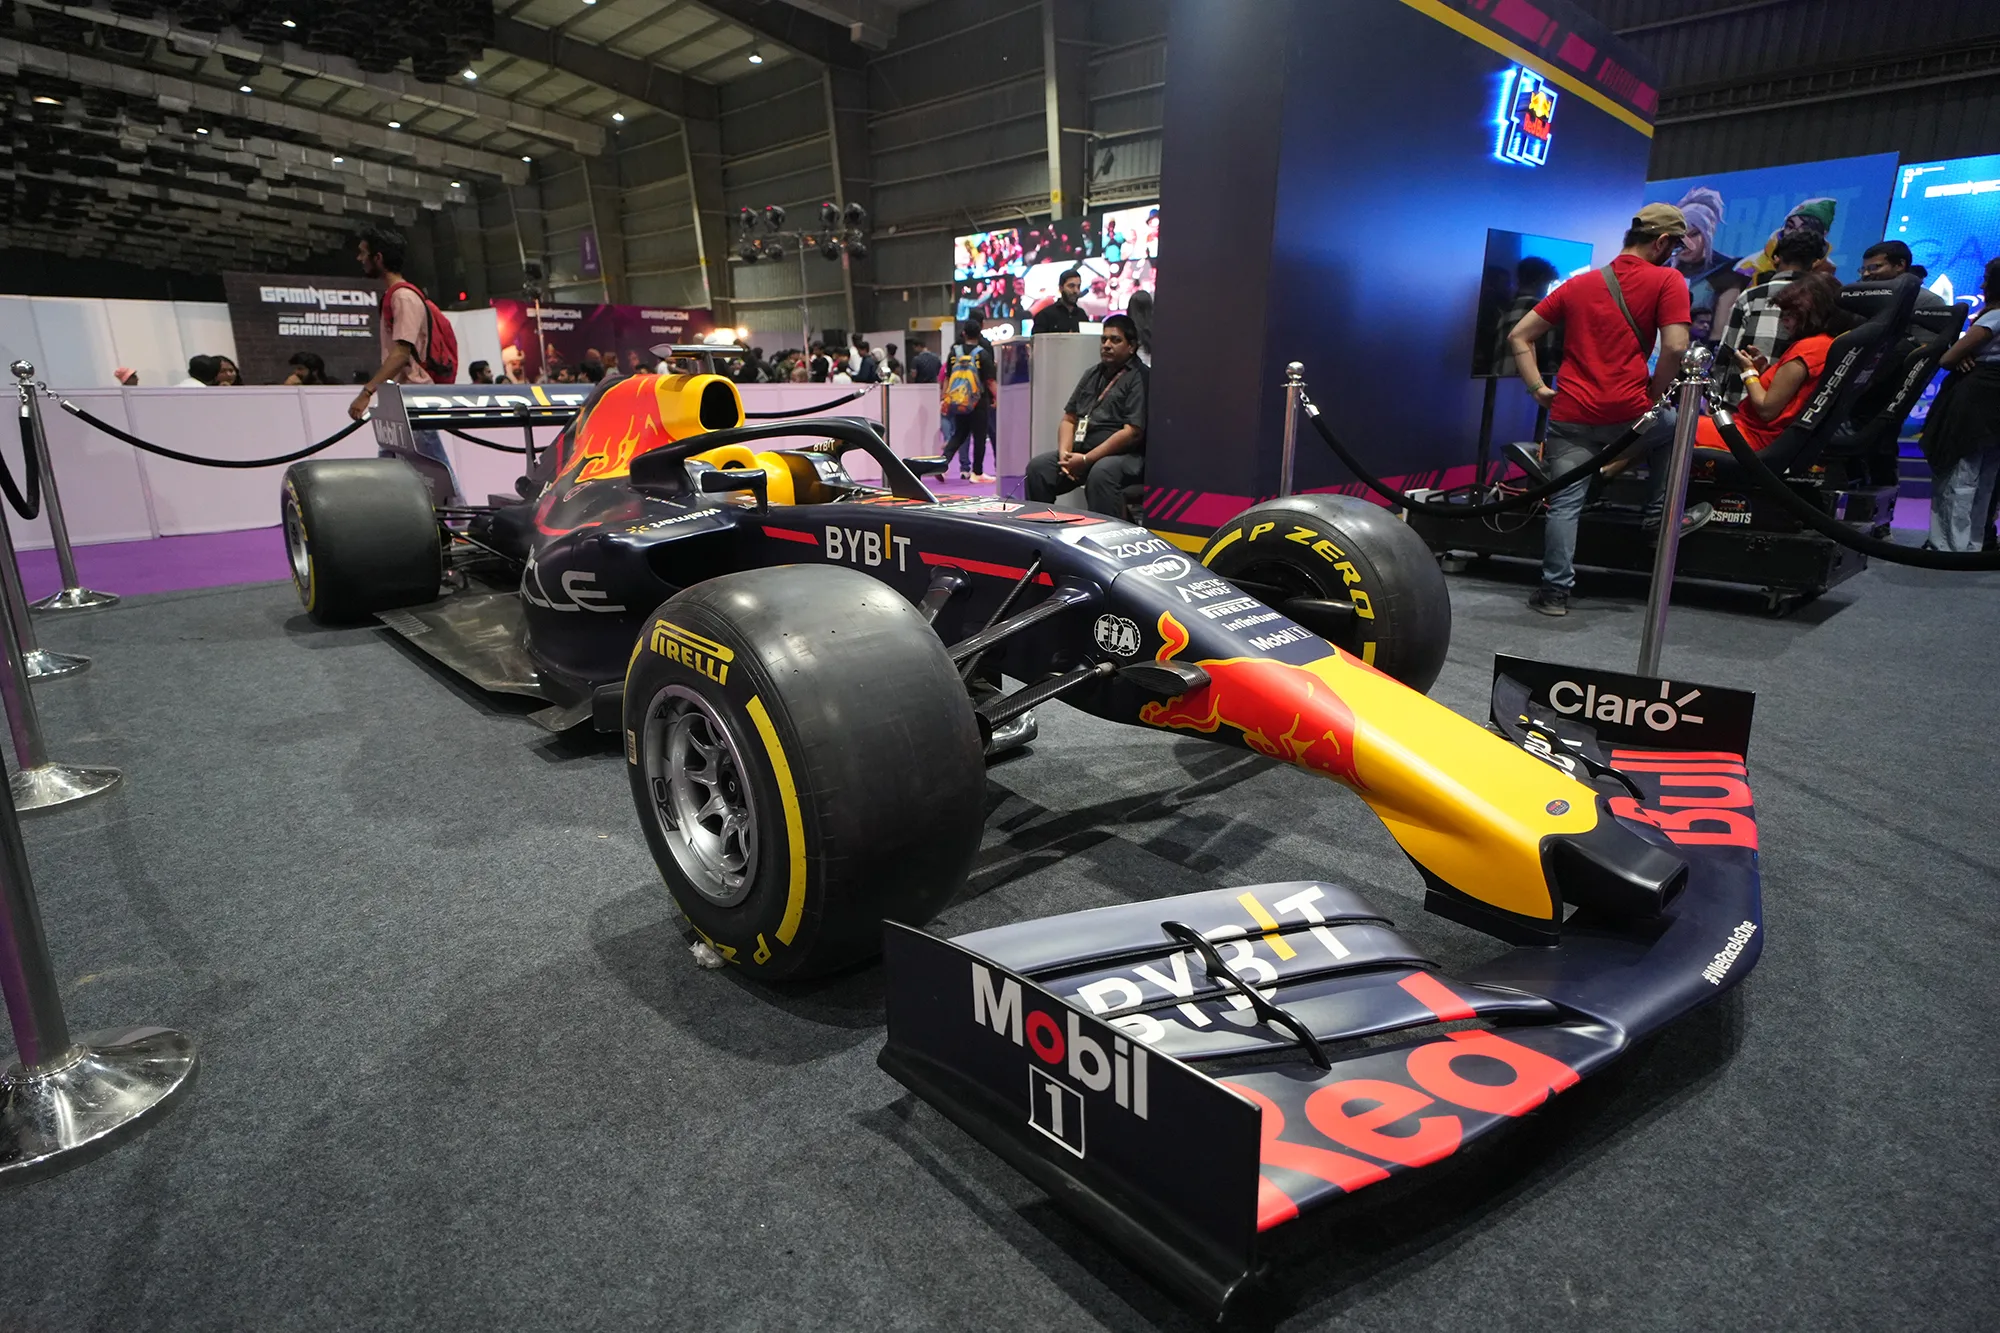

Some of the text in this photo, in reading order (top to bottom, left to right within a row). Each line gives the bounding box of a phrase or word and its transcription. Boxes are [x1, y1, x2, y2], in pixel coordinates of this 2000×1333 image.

[260, 285, 378, 310] GAMINGCON
[279, 323, 338, 337] GAMING
[305, 312, 370, 326] BIGGEST
[649, 508, 721, 528] Walmart
[1711, 510, 1752, 525] ESPORTS
[825, 523, 911, 572] BYBIT
[1108, 538, 1172, 559] zoom
[1137, 559, 1182, 576] CDW
[1248, 521, 1375, 620] P ZERO
[1187, 578, 1225, 592] ARCTIC
[1201, 585, 1232, 598] WOLF
[1197, 596, 1261, 620] PIRELLI
[1221, 612, 1282, 632] infinitum
[1248, 628, 1300, 652] Mobil
[649, 619, 735, 686] PIRELLI
[1549, 680, 1679, 732] Claro
[1608, 749, 1759, 851] Bull
[1701, 920, 1758, 986] #WeRaceAsOne
[1076, 885, 1351, 1046] BYBIT
[971, 961, 1149, 1120] Mobil
[1218, 971, 1581, 1232] Red
